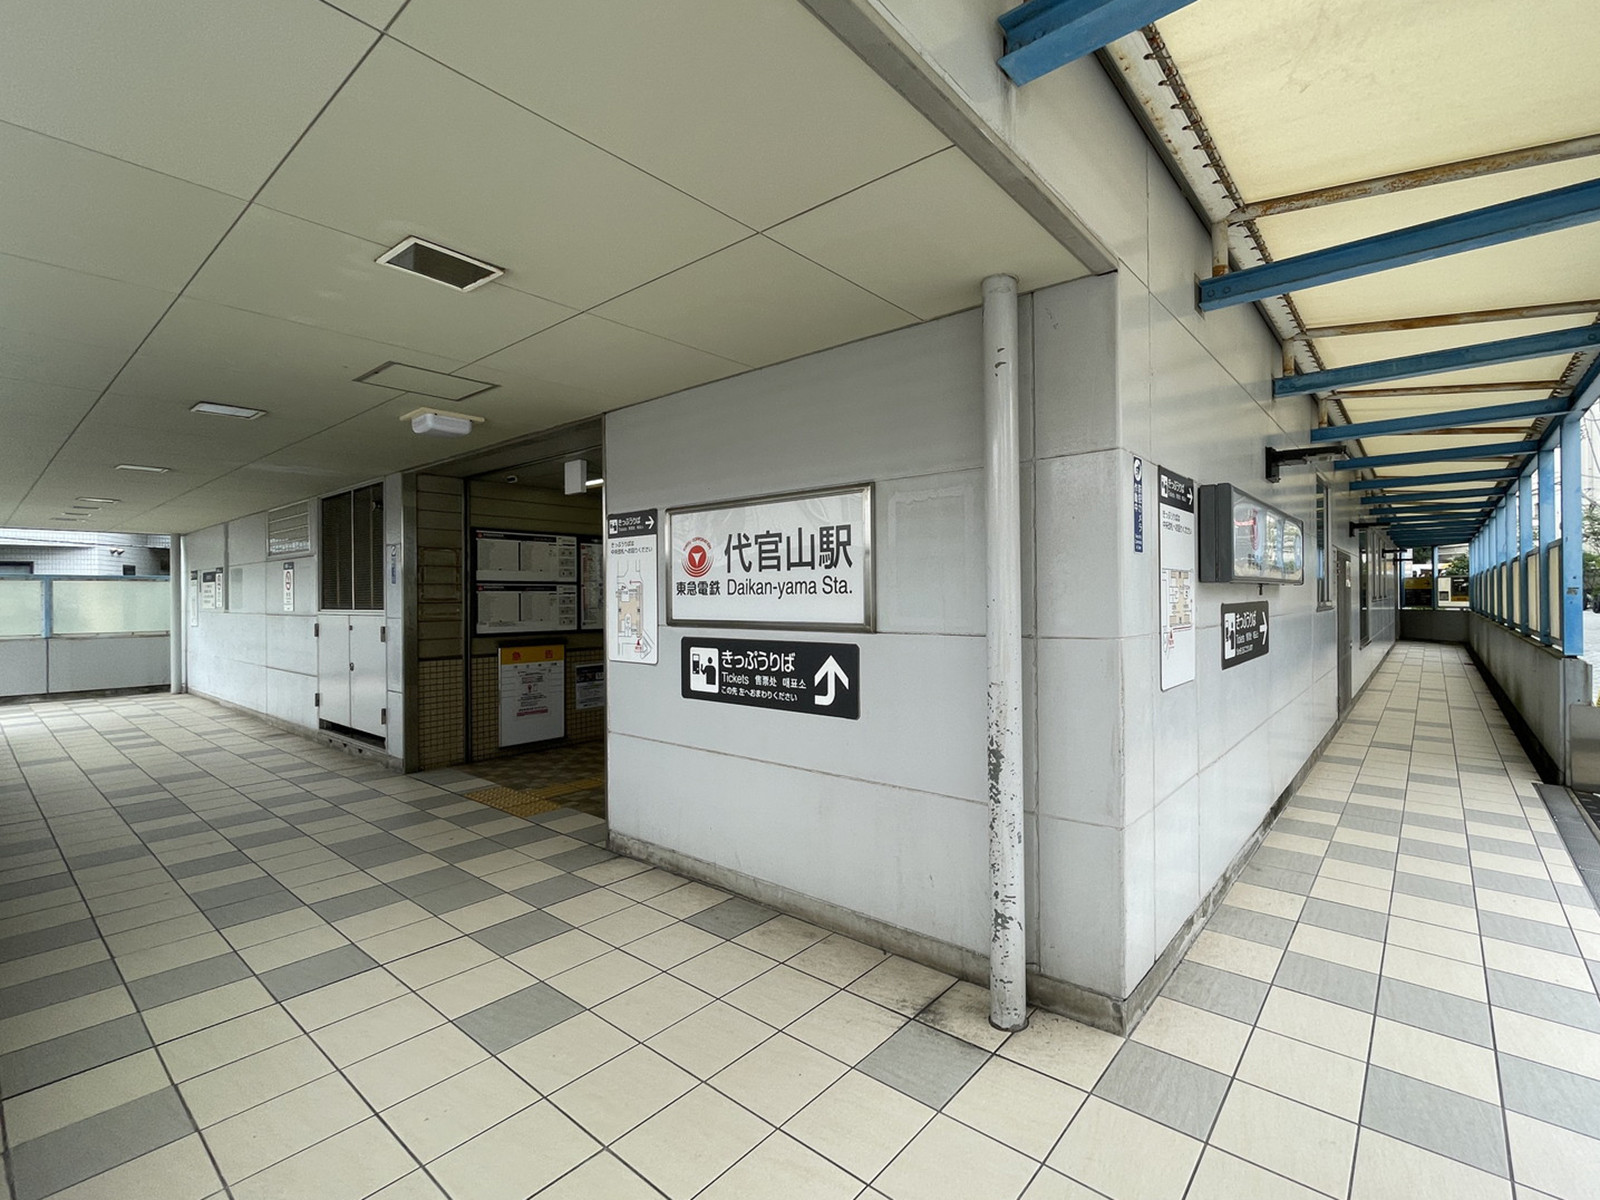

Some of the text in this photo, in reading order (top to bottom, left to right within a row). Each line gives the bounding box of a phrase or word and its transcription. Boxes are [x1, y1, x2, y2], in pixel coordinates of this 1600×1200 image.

[724, 524, 853, 574] 代官山駅
[676, 580, 721, 596] 東急電鉄
[727, 575, 852, 599] Daikan-yama Sta.
[721, 649, 796, 673] きっぷうりば
[721, 671, 750, 685] Tickets
